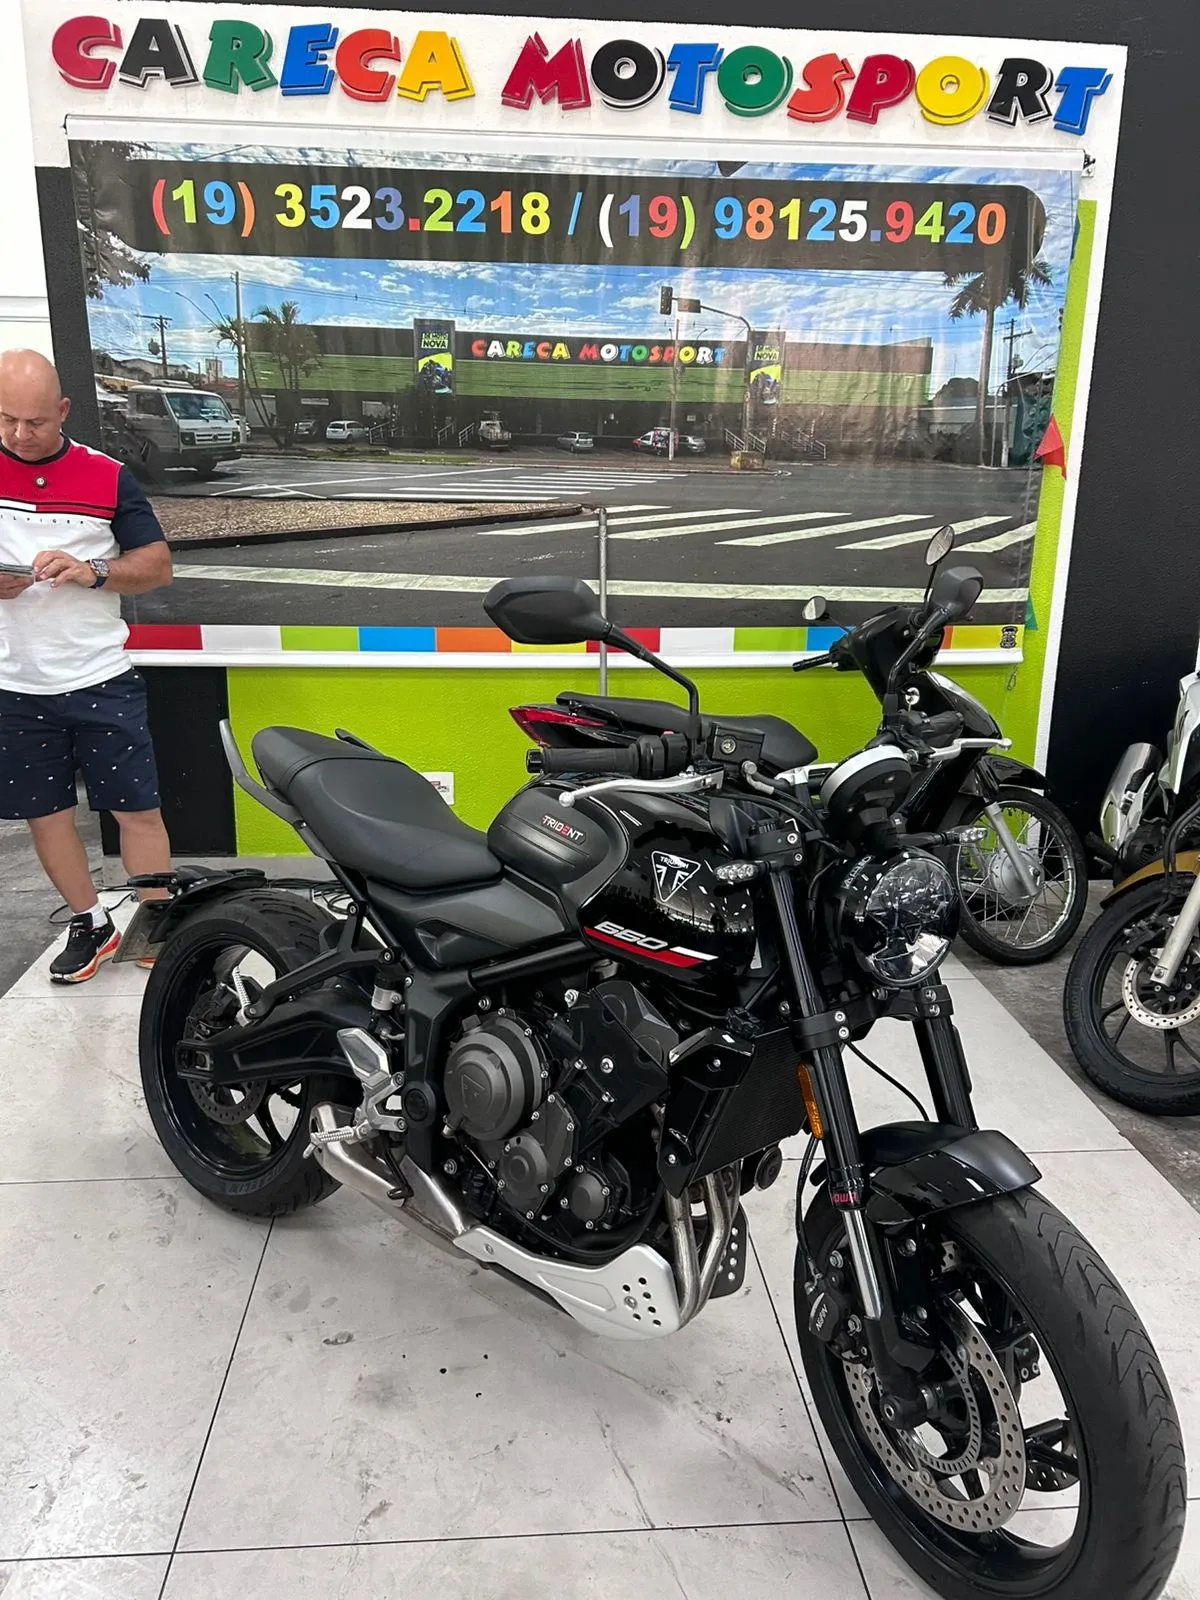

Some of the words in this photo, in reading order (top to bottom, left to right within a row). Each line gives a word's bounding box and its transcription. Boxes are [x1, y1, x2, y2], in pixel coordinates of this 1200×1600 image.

[51, 15, 475, 102] CARECA
[501, 31, 1112, 135] MOTOSPORT
[152, 178, 256, 238] (19)
[273, 182, 551, 236] 3523.2218
[598, 193, 696, 250] (19)
[713, 196, 1007, 246] 98125.9420
[471, 339, 571, 360] CARECA
[578, 343, 727, 364] MOTOSPORT
[542, 814, 584, 841] TRIDENT
[660, 855, 690, 869] TRIUH
[594, 920, 669, 950] 660
